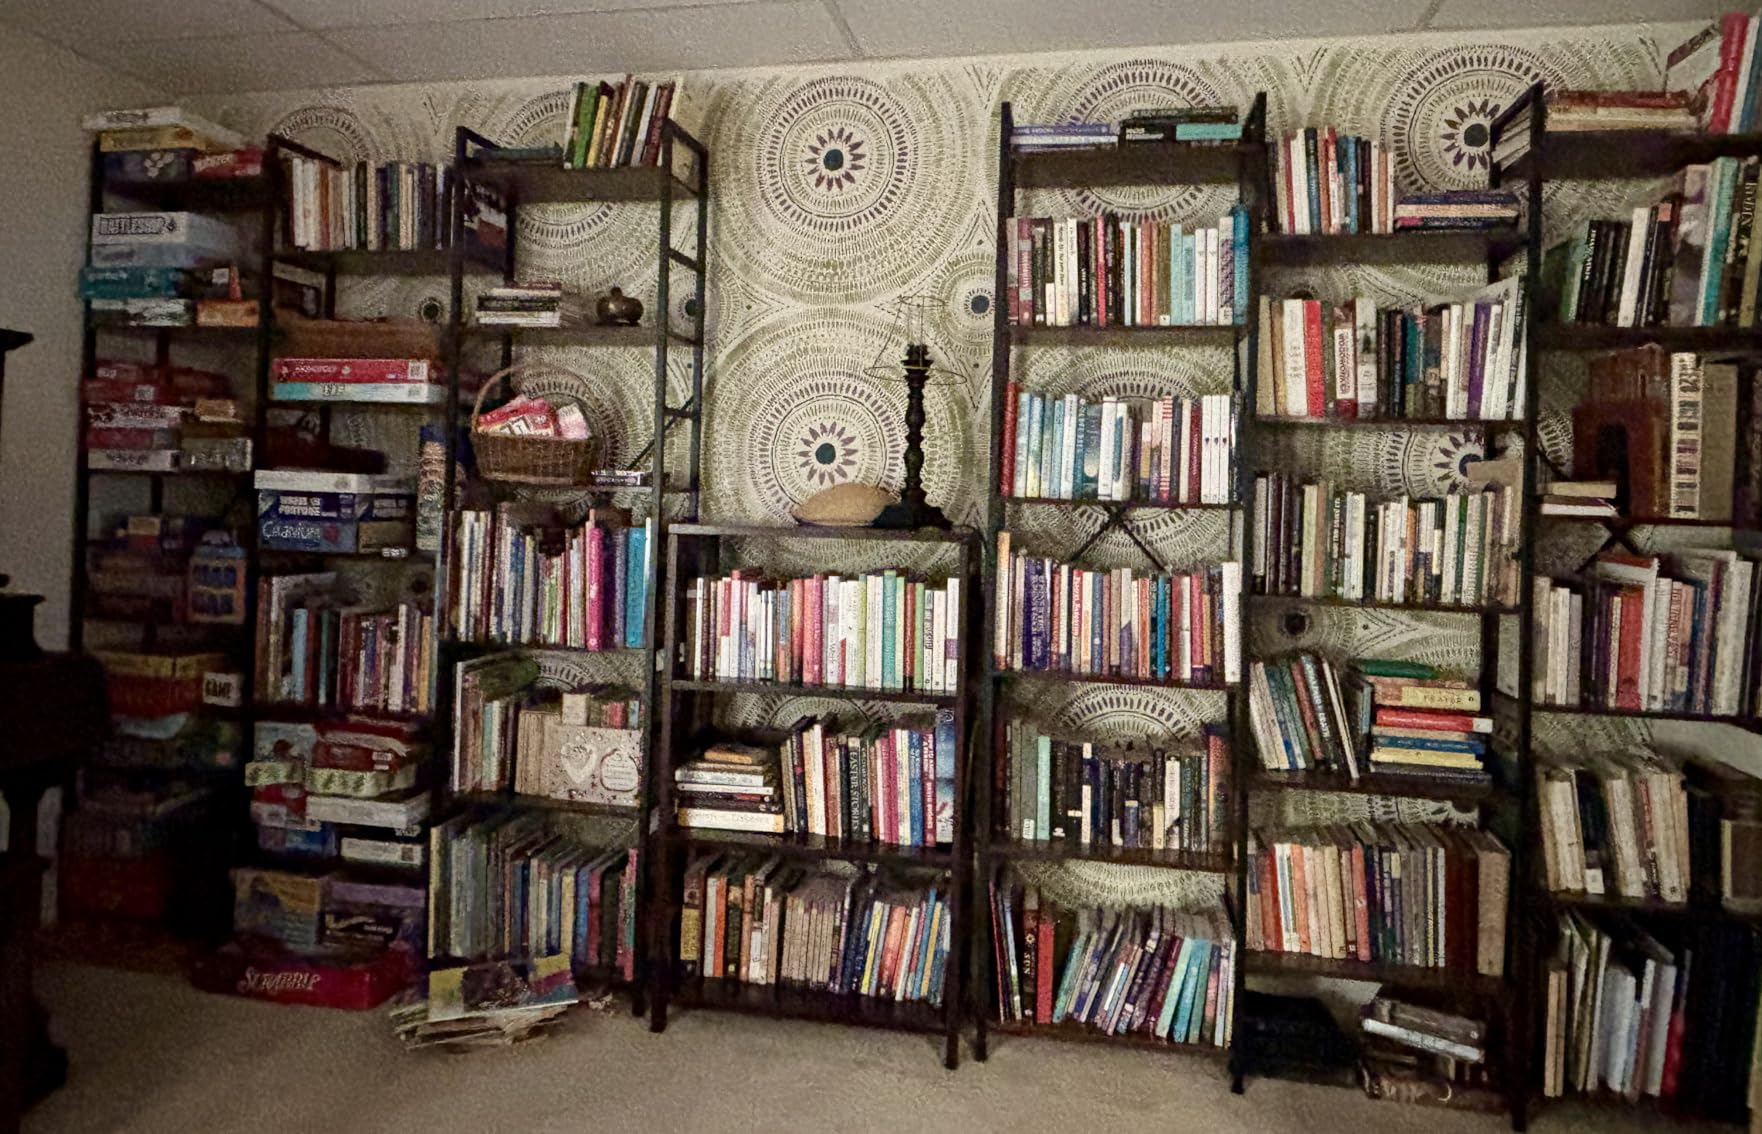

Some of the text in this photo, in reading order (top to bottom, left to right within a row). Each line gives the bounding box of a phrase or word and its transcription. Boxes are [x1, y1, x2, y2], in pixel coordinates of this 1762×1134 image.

[278, 505, 321, 516] FORTUNE
[850, 751, 860, 831] EASTER STORIES
